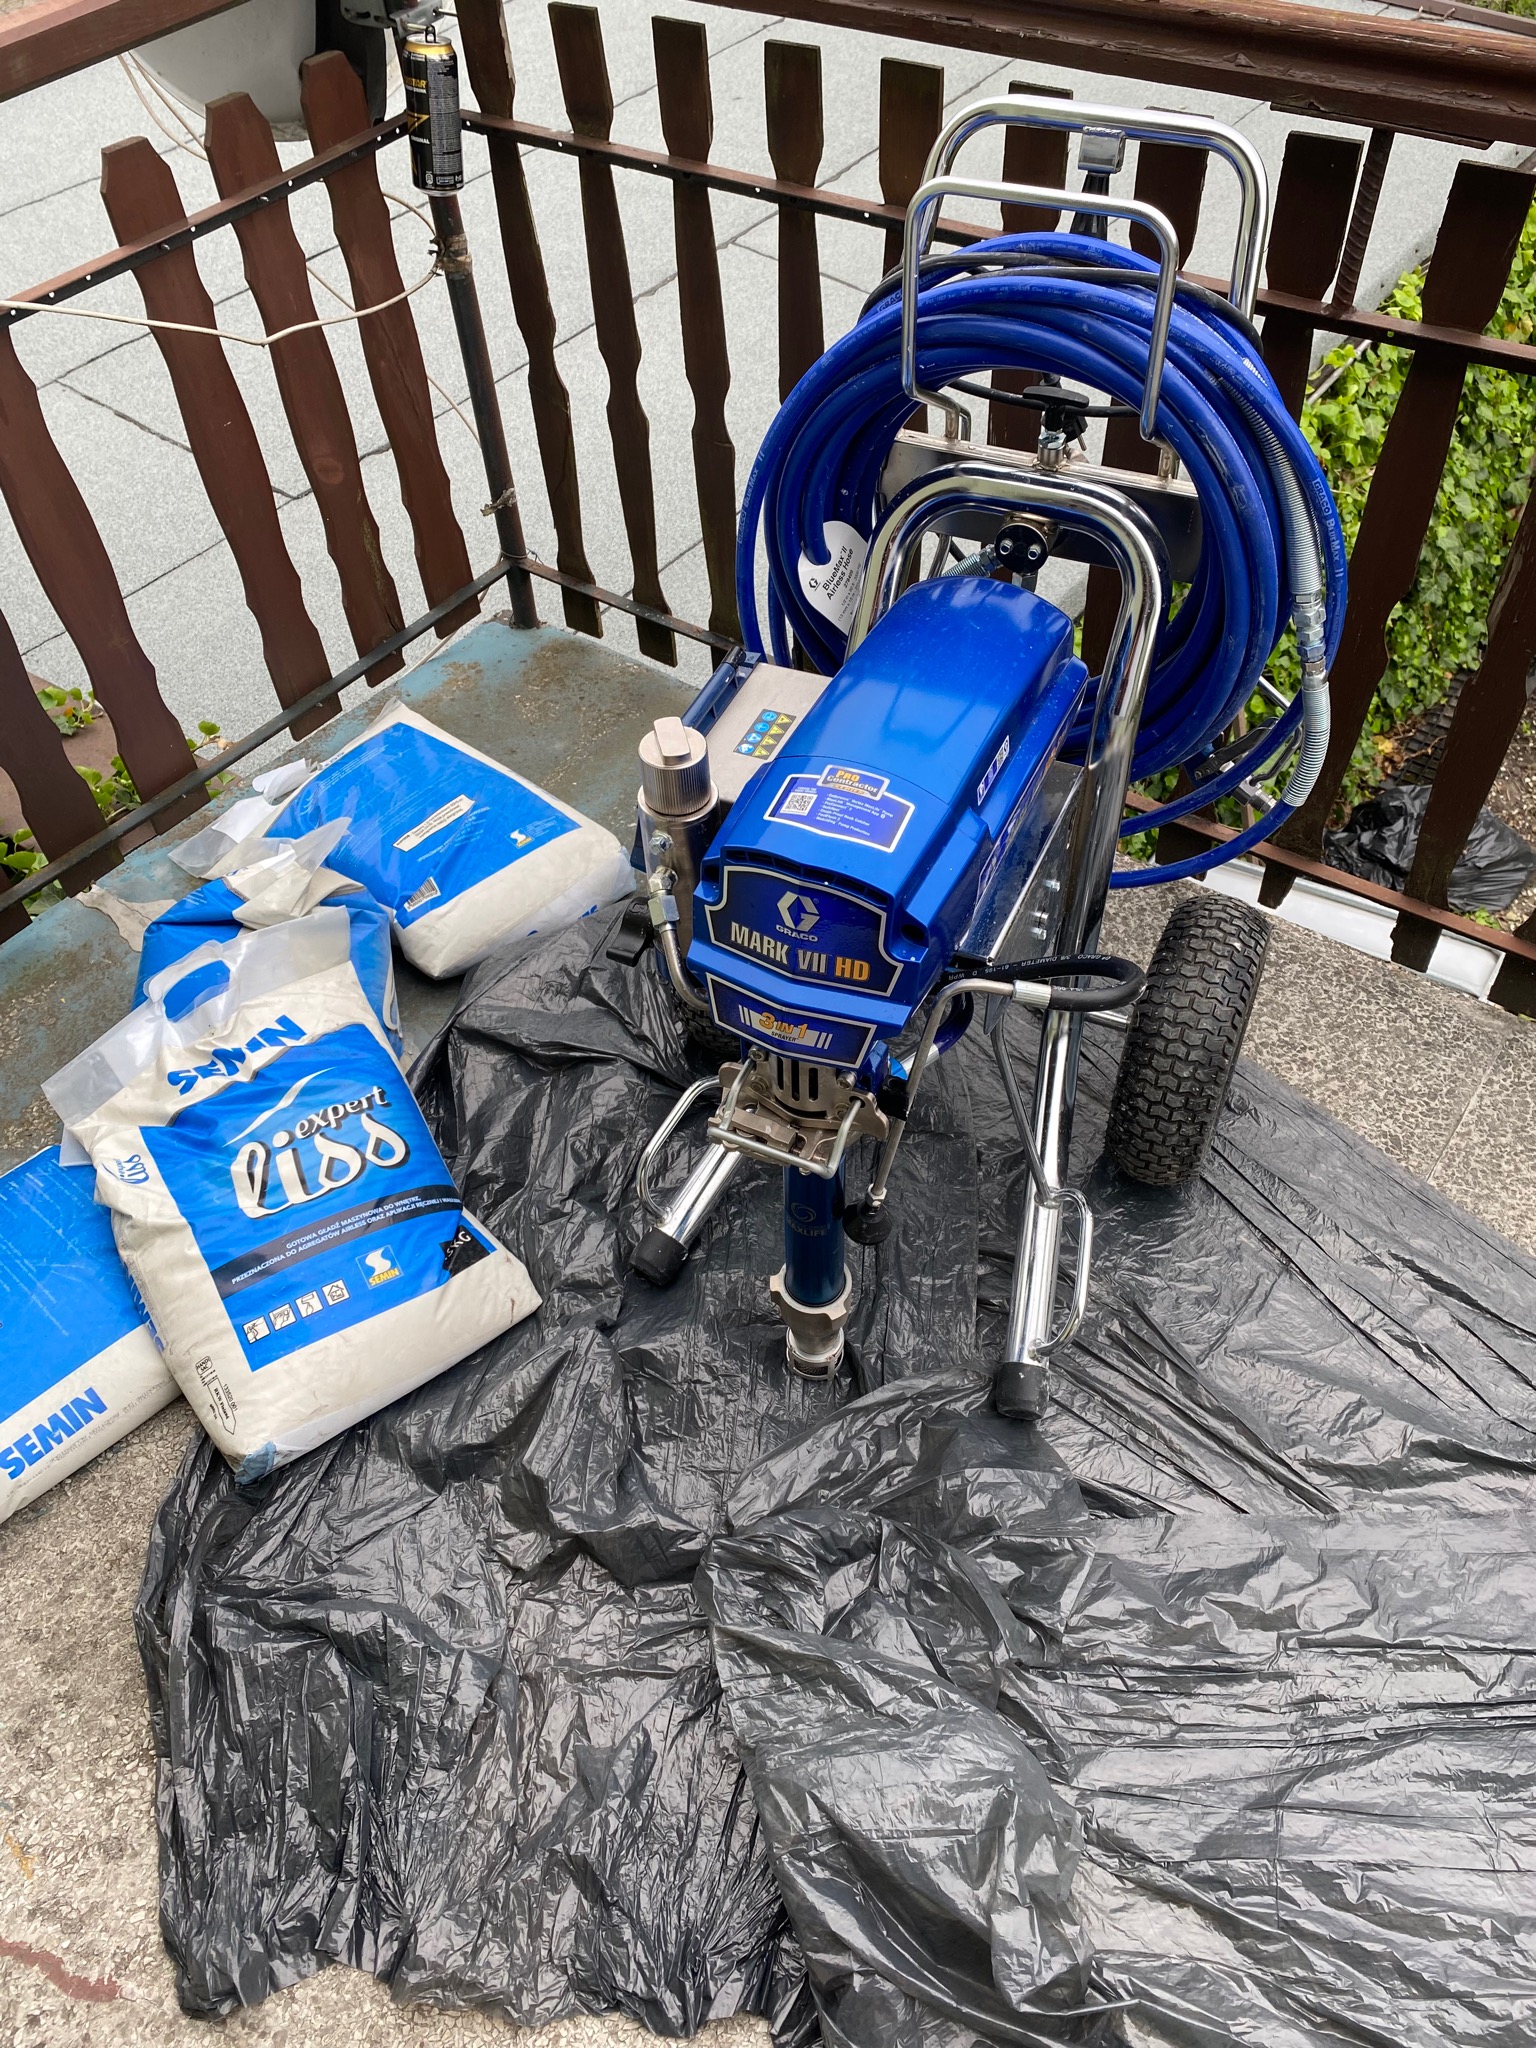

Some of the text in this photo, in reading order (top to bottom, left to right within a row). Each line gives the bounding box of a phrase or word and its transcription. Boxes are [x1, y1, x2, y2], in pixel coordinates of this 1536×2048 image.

[1313, 479, 1331, 515] GRACO
[826, 548, 854, 601] Airless Hose
[827, 775, 879, 793] Contractor
[836, 770, 860, 782] PRO
[775, 924, 819, 942] GRACO
[731, 921, 871, 982] MARK VII HD
[1021, 956, 1059, 967] DIAMETER
[948, 972, 965, 981] WPR
[759, 1011, 808, 1039] 3 IN 1
[771, 1031, 798, 1042] SPRAYER
[295, 1086, 389, 1139] expert
[120, 1154, 150, 1185] liss
[230, 1113, 407, 1219] liss
[286, 1232, 318, 1249] GOTOWA
[317, 1221, 341, 1236] GŁADŹ
[340, 1206, 384, 1226] MASZYNOWA
[384, 1203, 394, 1211] DO
[231, 1254, 286, 1284] PRZEZNACZONA
[285, 1248, 297, 1258] DO
[298, 1230, 341, 1253] AGREGATÓW
[341, 1221, 367, 1235] AIRLESS
[366, 1214, 386, 1224] ORAZ
[385, 1204, 416, 1217] APLIKACJI
[369, 1267, 400, 1286] SEMIN
[0, 1386, 108, 1481] SEMIN
